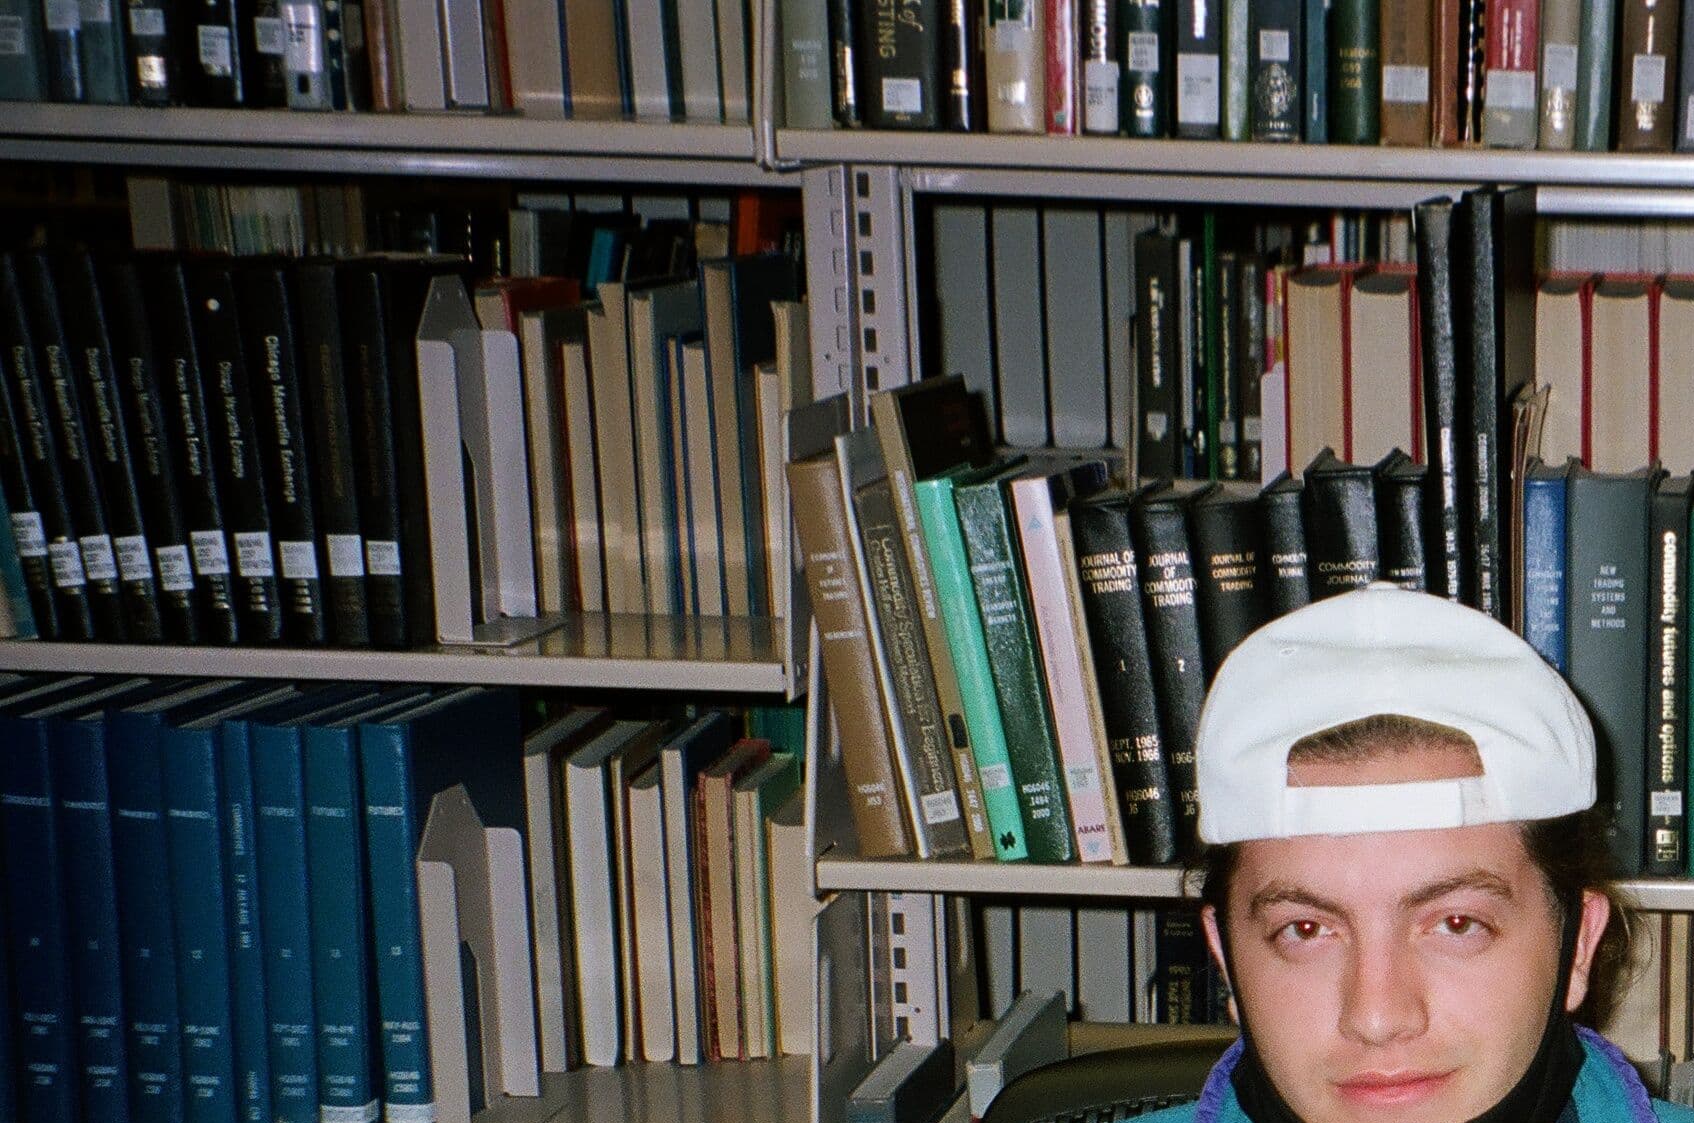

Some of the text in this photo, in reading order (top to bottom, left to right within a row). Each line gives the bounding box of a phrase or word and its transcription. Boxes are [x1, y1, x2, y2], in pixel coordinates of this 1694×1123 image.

[265, 334, 298, 503] Chicago Mercantile Exchange
[1080, 550, 1136, 568] JOURNAL OF
[1149, 551, 1190, 568] JOURNAL
[1082, 564, 1138, 581] COMMODITY
[1162, 566, 1176, 579] OF
[1318, 560, 1377, 573] COMMODITY
[1600, 565, 1617, 576] NEW
[1091, 578, 1133, 595] TRADING
[1145, 577, 1198, 595] COMMODITY
[1326, 573, 1370, 586] JOURNAL
[1593, 578, 1624, 589] TRADING
[1152, 592, 1194, 608] TRADING
[1591, 591, 1626, 603] SYSTEMS
[1601, 605, 1616, 615] AND
[1591, 618, 1626, 629] METHODS
[1659, 531, 1678, 784] commodity futures and options
